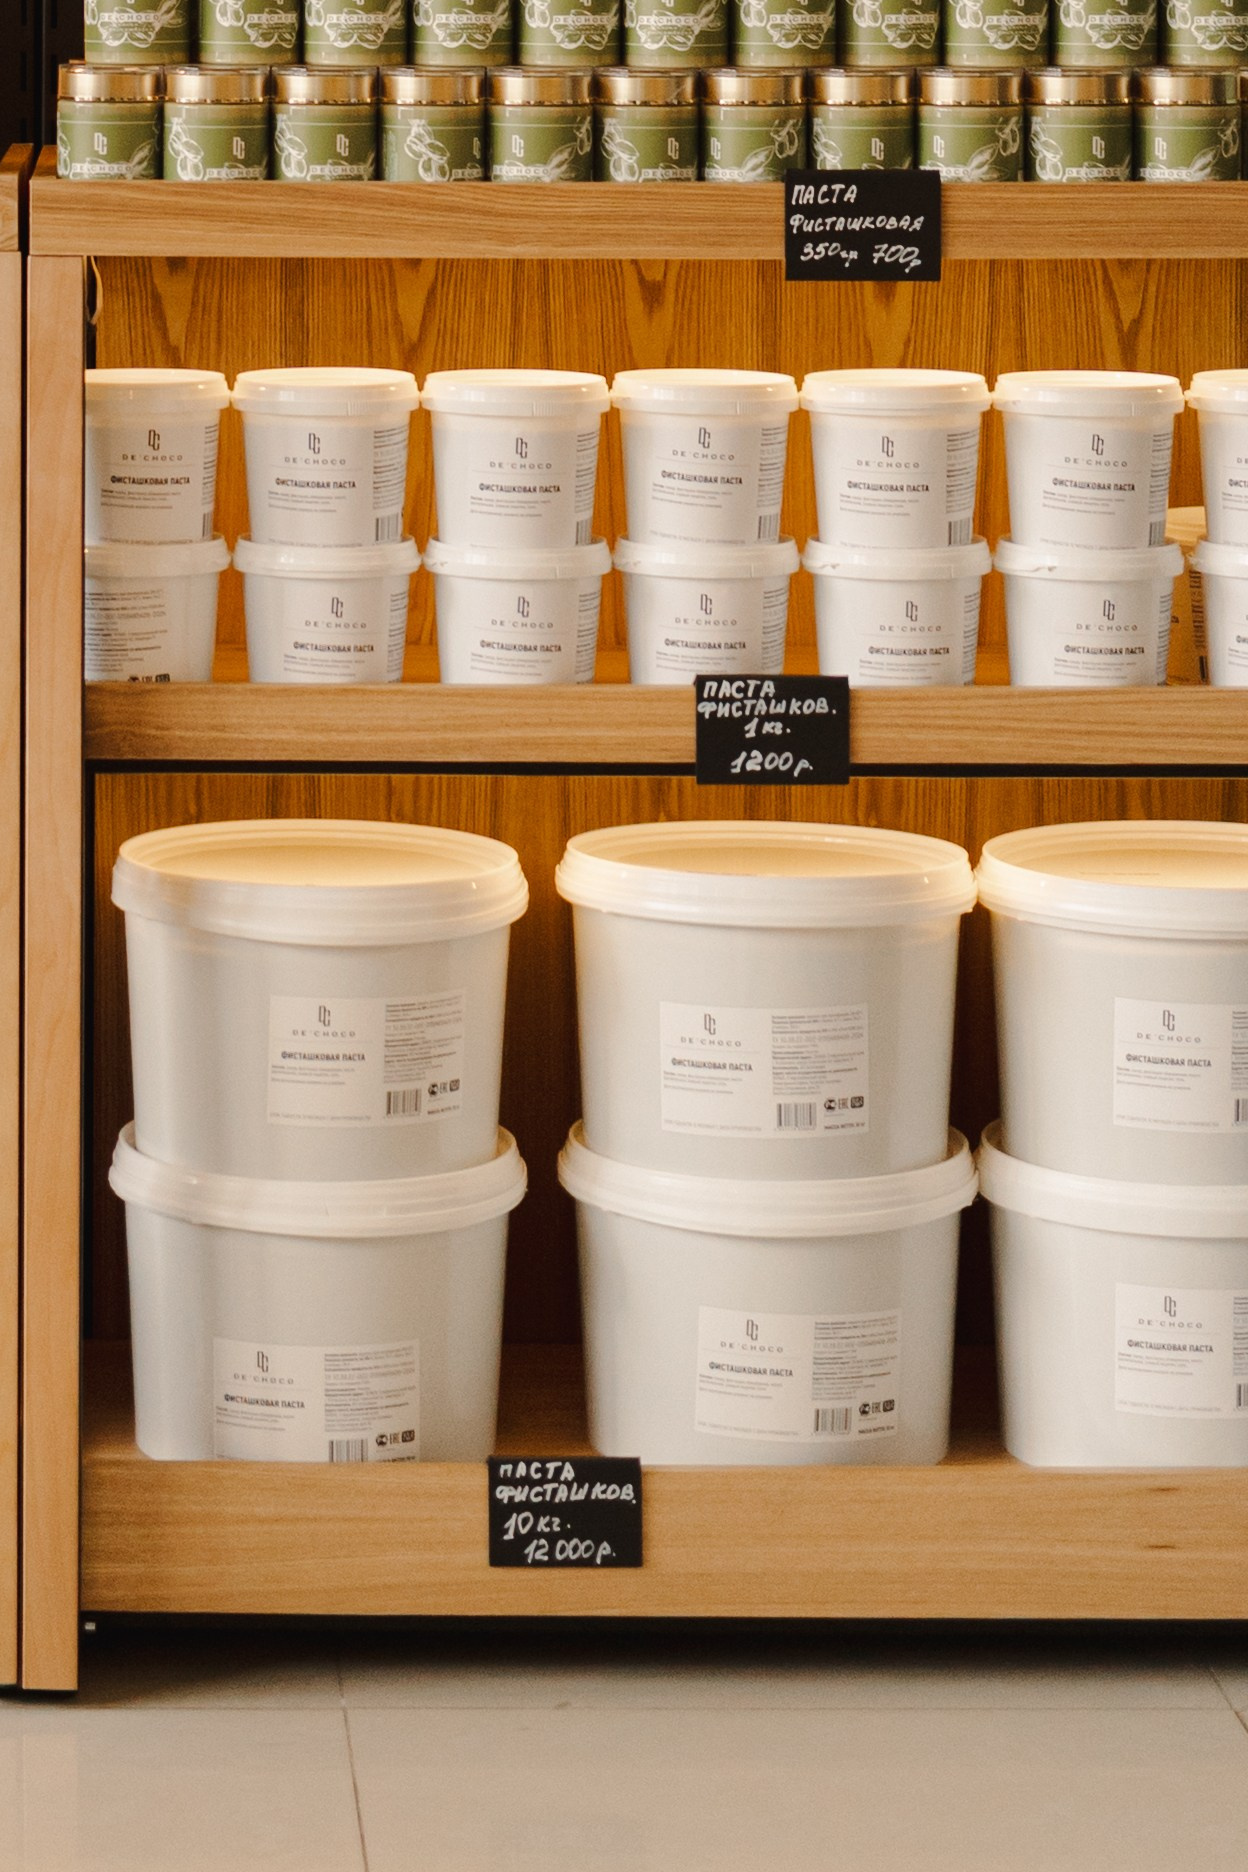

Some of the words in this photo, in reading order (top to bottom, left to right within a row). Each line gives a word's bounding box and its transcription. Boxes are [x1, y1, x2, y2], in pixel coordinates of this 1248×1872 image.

[791, 184, 857, 205] ПАСТА
[790, 214, 924, 234] ФИСТАШКОВАЯ
[333, 480, 356, 489] ПАСТА
[539, 484, 560, 494] ПАСТА
[906, 484, 929, 493] ПАСТА
[1114, 483, 1135, 492] ПАСТА
[703, 680, 775, 698] ПАСТА
[697, 697, 837, 719] ФИСТАШКОВ.
[744, 717, 758, 738] 1
[342, 1053, 365, 1062] ПАСТА
[729, 1062, 753, 1072] ПАСТА
[1187, 1058, 1211, 1068] ПАСТА
[1189, 1344, 1213, 1353] ПАСТА
[769, 1368, 793, 1377] ПАСТА
[281, 1400, 305, 1409] ПАСТА
[500, 1461, 575, 1481] ПАСТА
[495, 1482, 636, 1504] ФИСТАШКОВ.
[503, 1512, 534, 1540] 10
